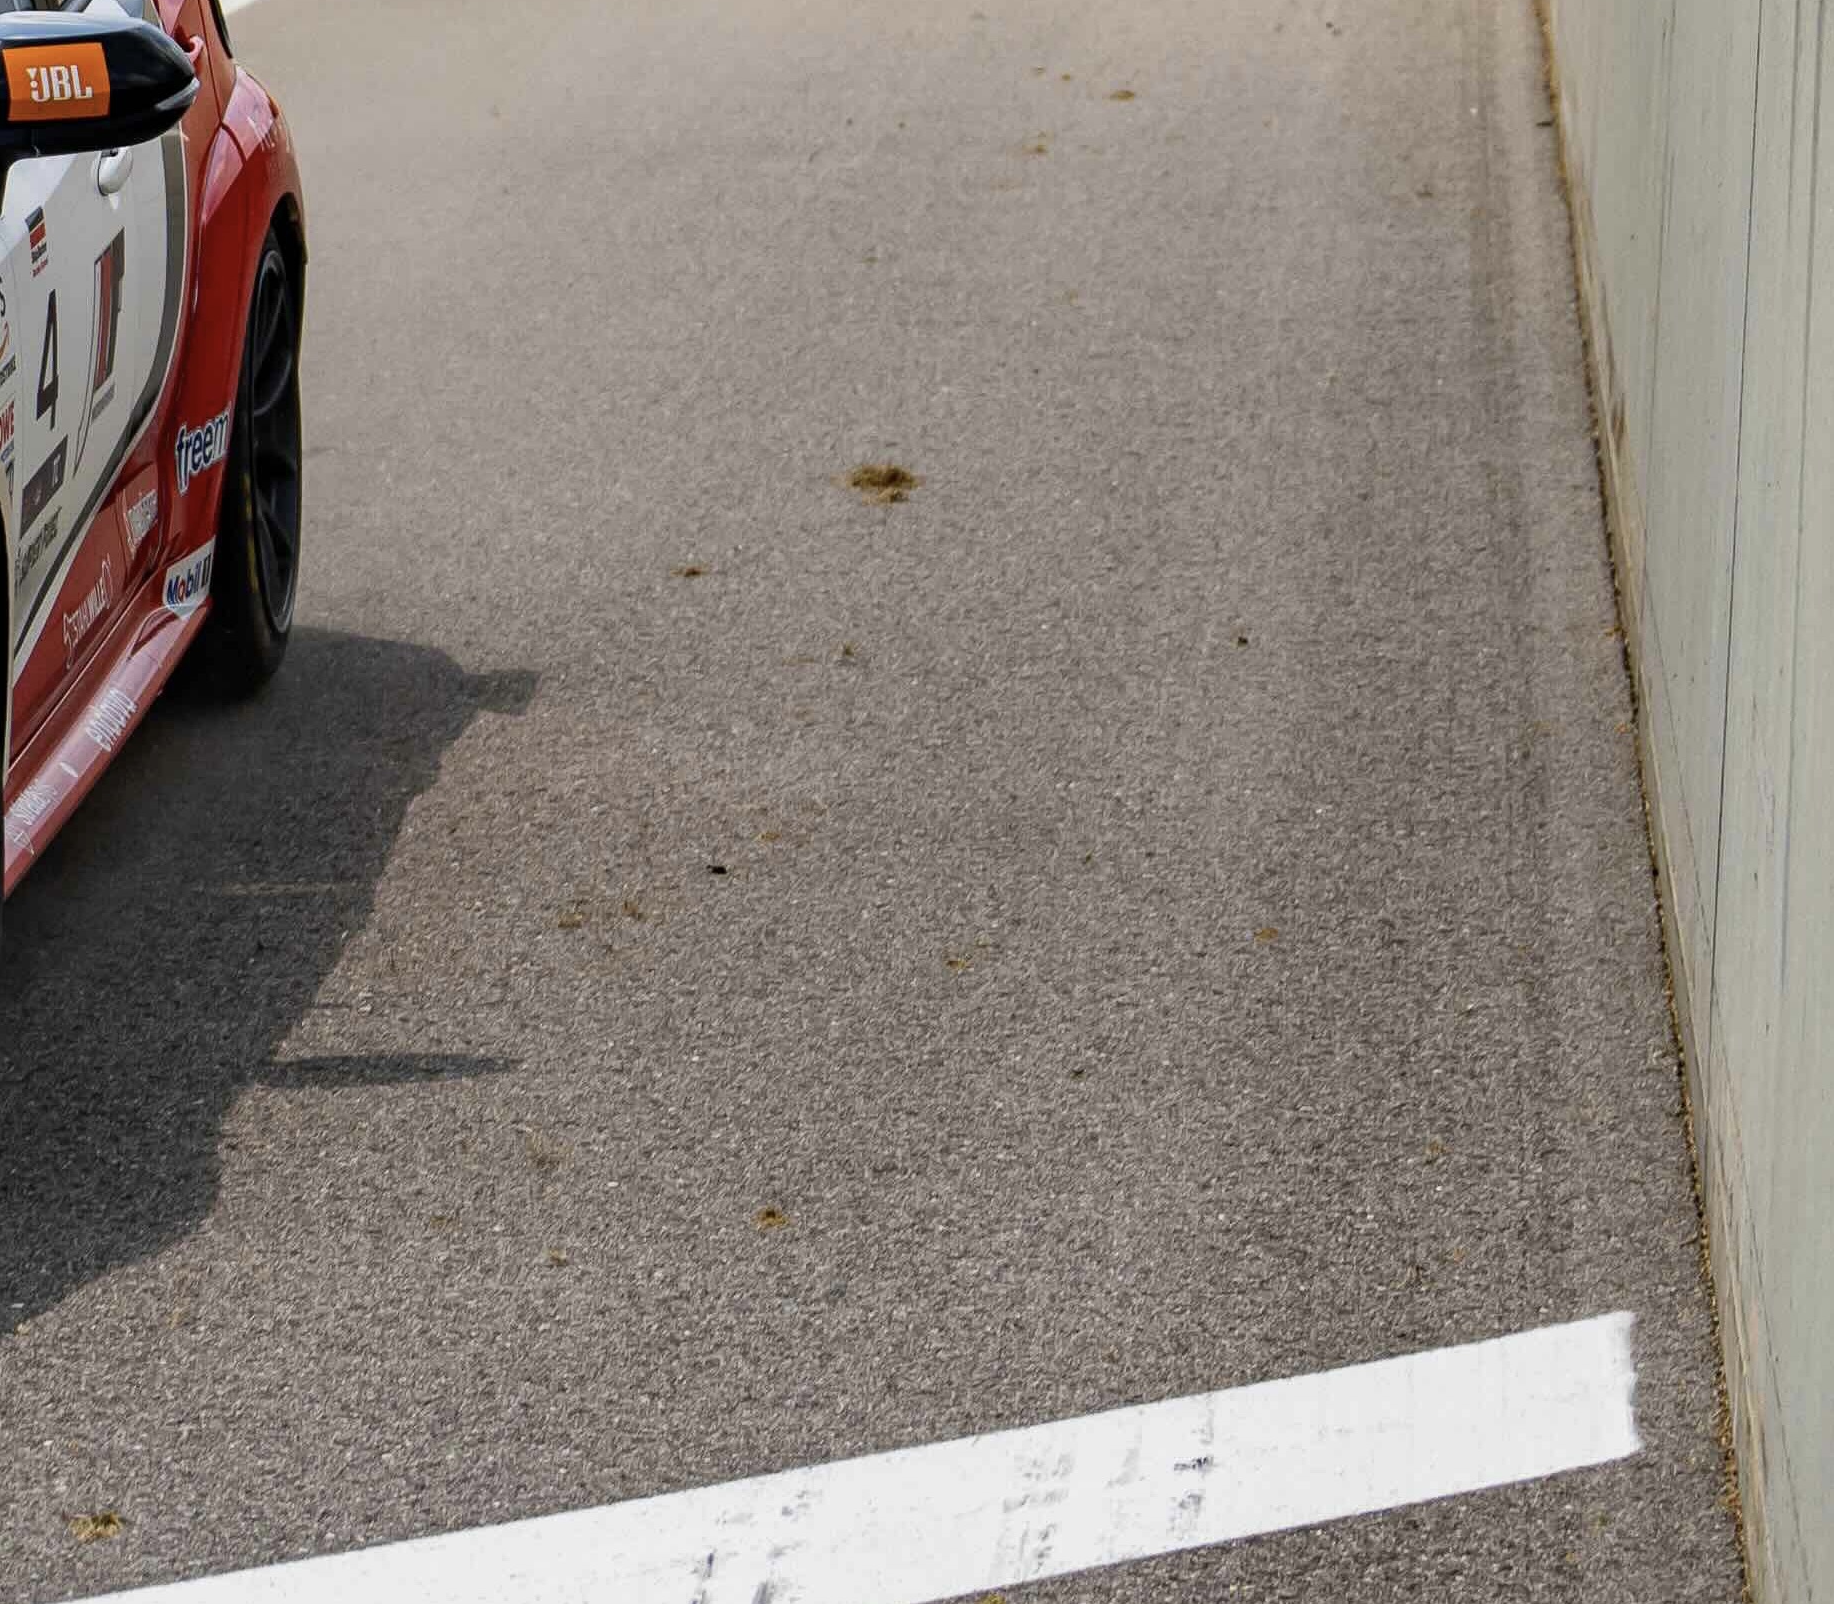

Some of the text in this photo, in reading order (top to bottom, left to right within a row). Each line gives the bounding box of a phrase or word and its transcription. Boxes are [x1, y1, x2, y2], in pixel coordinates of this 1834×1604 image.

[25, 64, 93, 102] JBL
[36, 288, 59, 430] 4
[166, 561, 202, 604] Mobil
